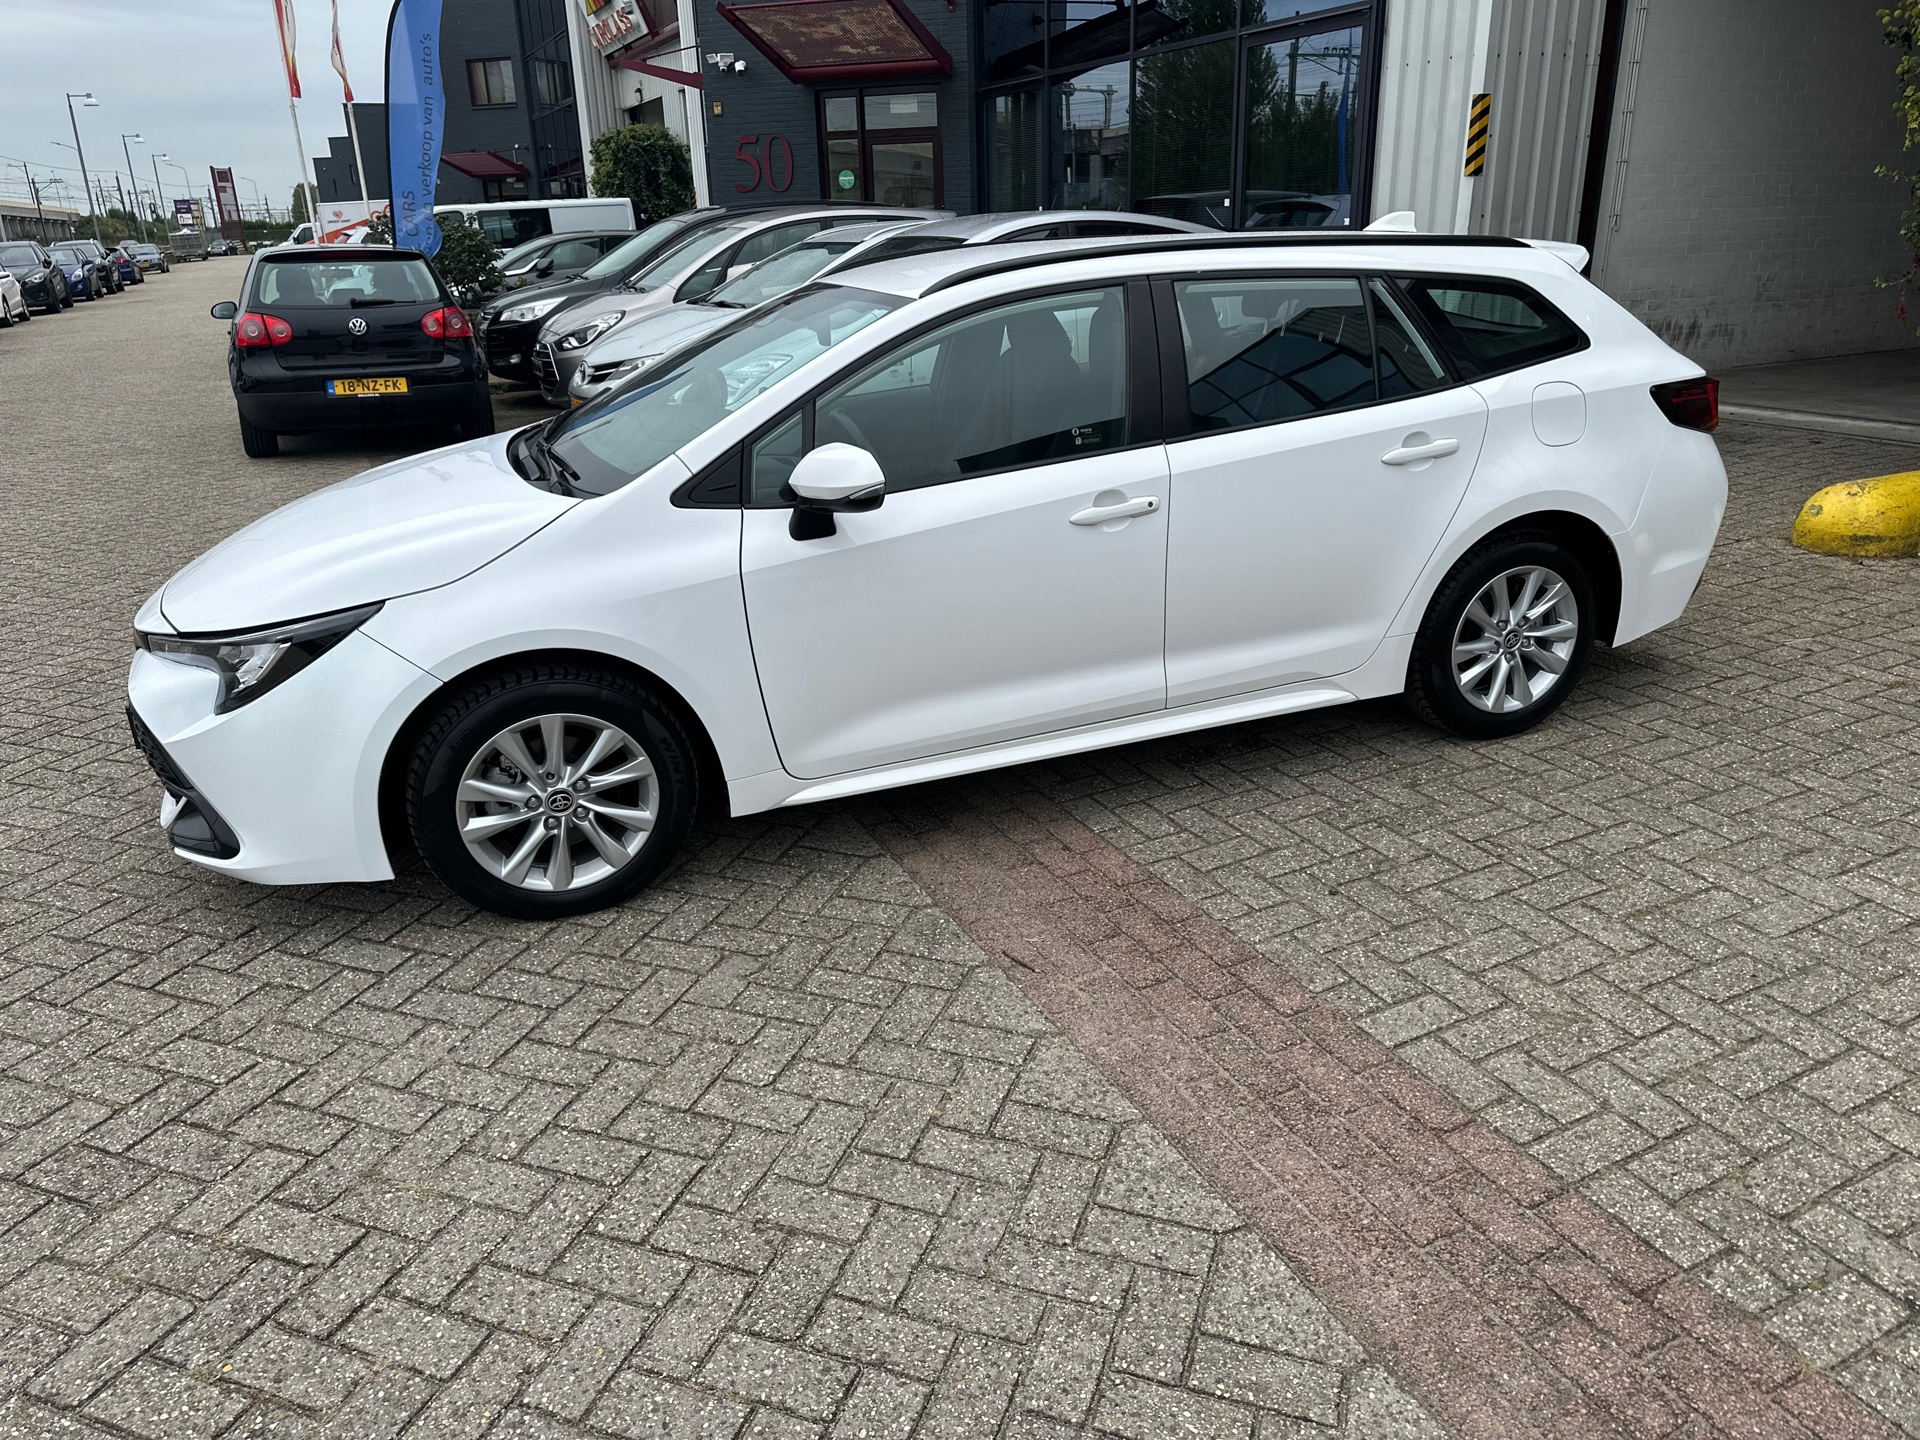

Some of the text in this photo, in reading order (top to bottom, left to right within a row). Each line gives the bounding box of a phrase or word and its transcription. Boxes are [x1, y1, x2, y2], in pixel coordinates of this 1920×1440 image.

[420, 32, 433, 86] auto's
[423, 96, 434, 126] van
[417, 130, 435, 197] verkoop
[735, 133, 794, 193] 50
[402, 190, 419, 237] CARS
[423, 202, 433, 221] en
[341, 379, 401, 393] 18-NZ-FK
